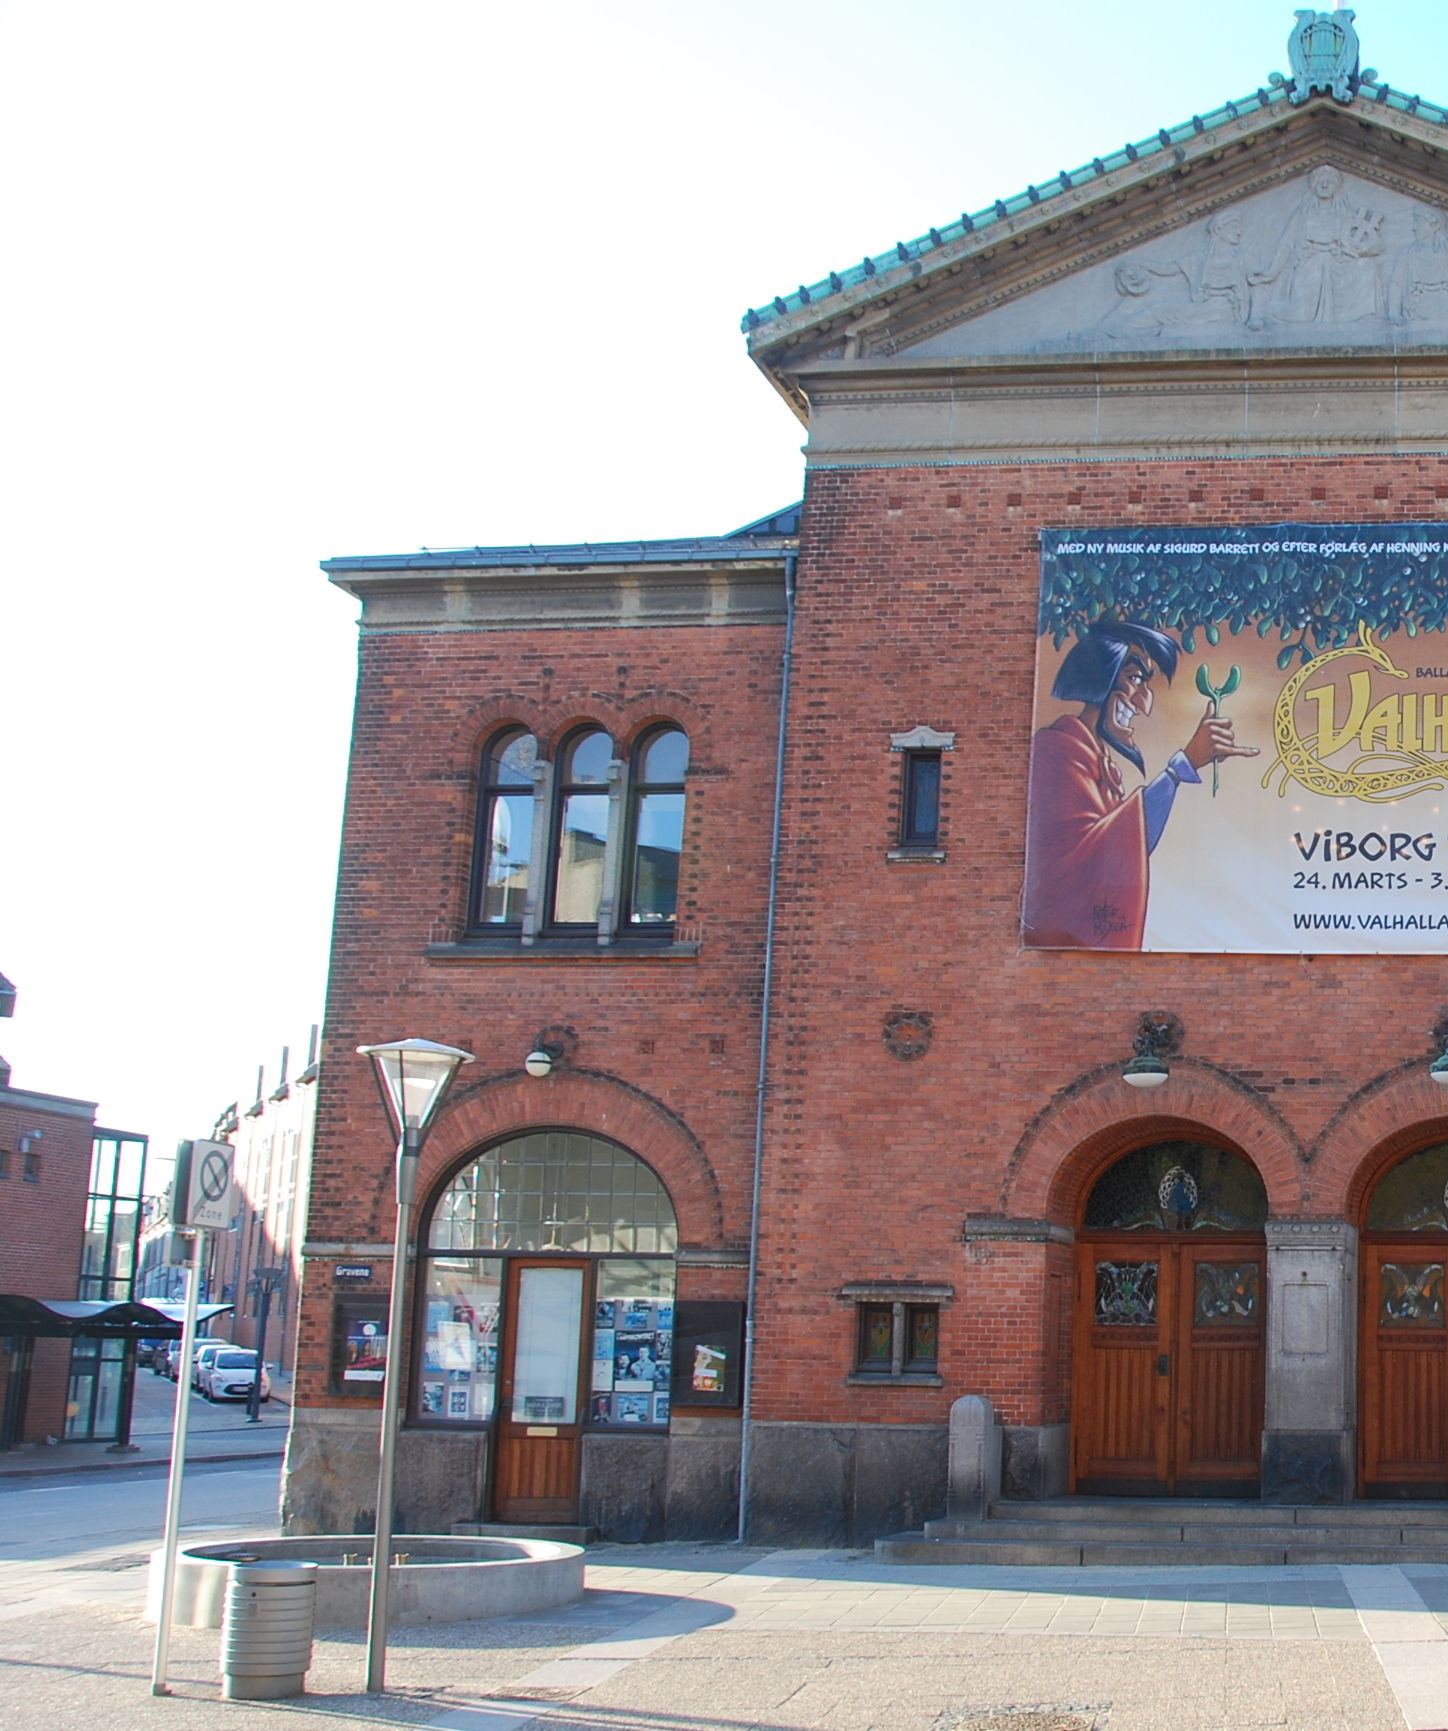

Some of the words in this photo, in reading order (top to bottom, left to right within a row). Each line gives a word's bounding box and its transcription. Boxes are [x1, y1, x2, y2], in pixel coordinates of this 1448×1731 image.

[1057, 543, 1085, 554] MED
[1087, 543, 1104, 554] NY
[1106, 543, 1144, 554] MUSIK
[1146, 543, 1161, 554] AF
[1164, 543, 1207, 554] SIGURD
[1209, 542, 1260, 554] BARRETT
[1262, 541, 1279, 552] OG
[1281, 541, 1317, 553] EFTER
[1369, 541, 1384, 553] AF
[1387, 541, 1440, 553] HENNING
[1293, 872, 1327, 890] 24.
[1332, 872, 1408, 890] MARTS
[1430, 872, 1448, 890] 3.
